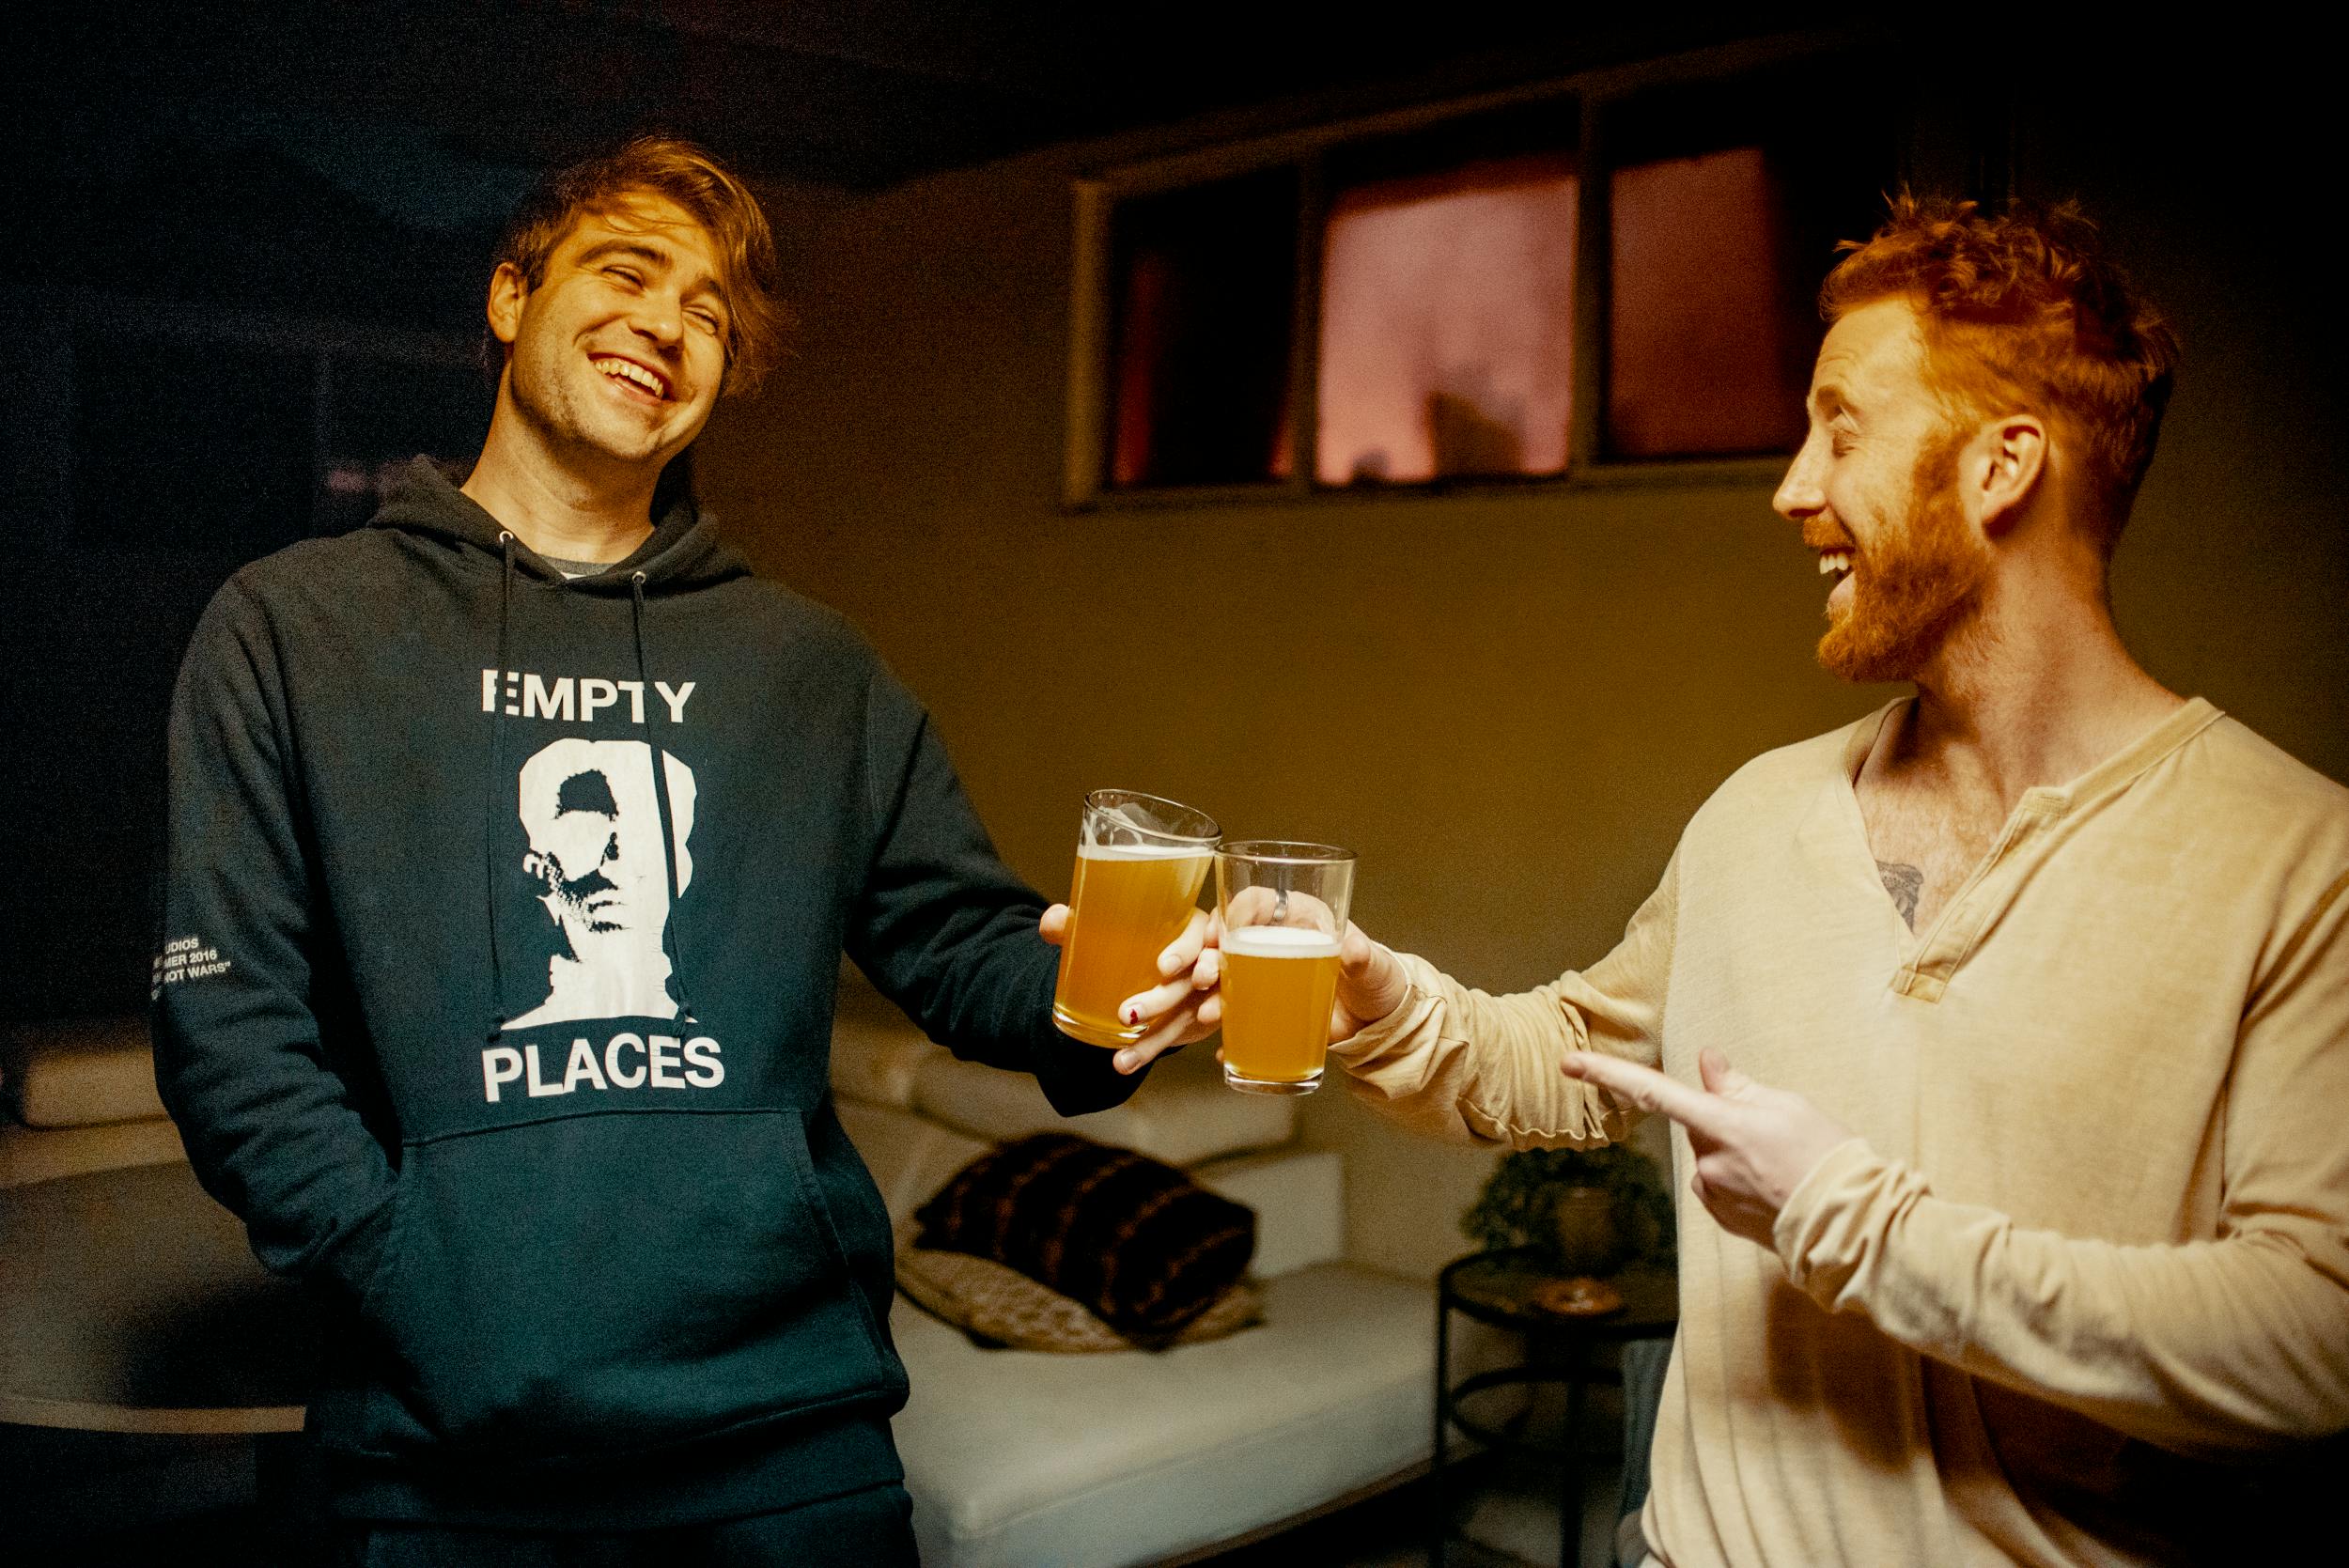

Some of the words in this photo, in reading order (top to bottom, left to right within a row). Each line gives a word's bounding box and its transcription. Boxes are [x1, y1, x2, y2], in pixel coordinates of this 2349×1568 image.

[482, 669, 696, 723] EMPTY
[189, 949, 217, 963] 2016
[482, 1032, 725, 1103] PLACES
